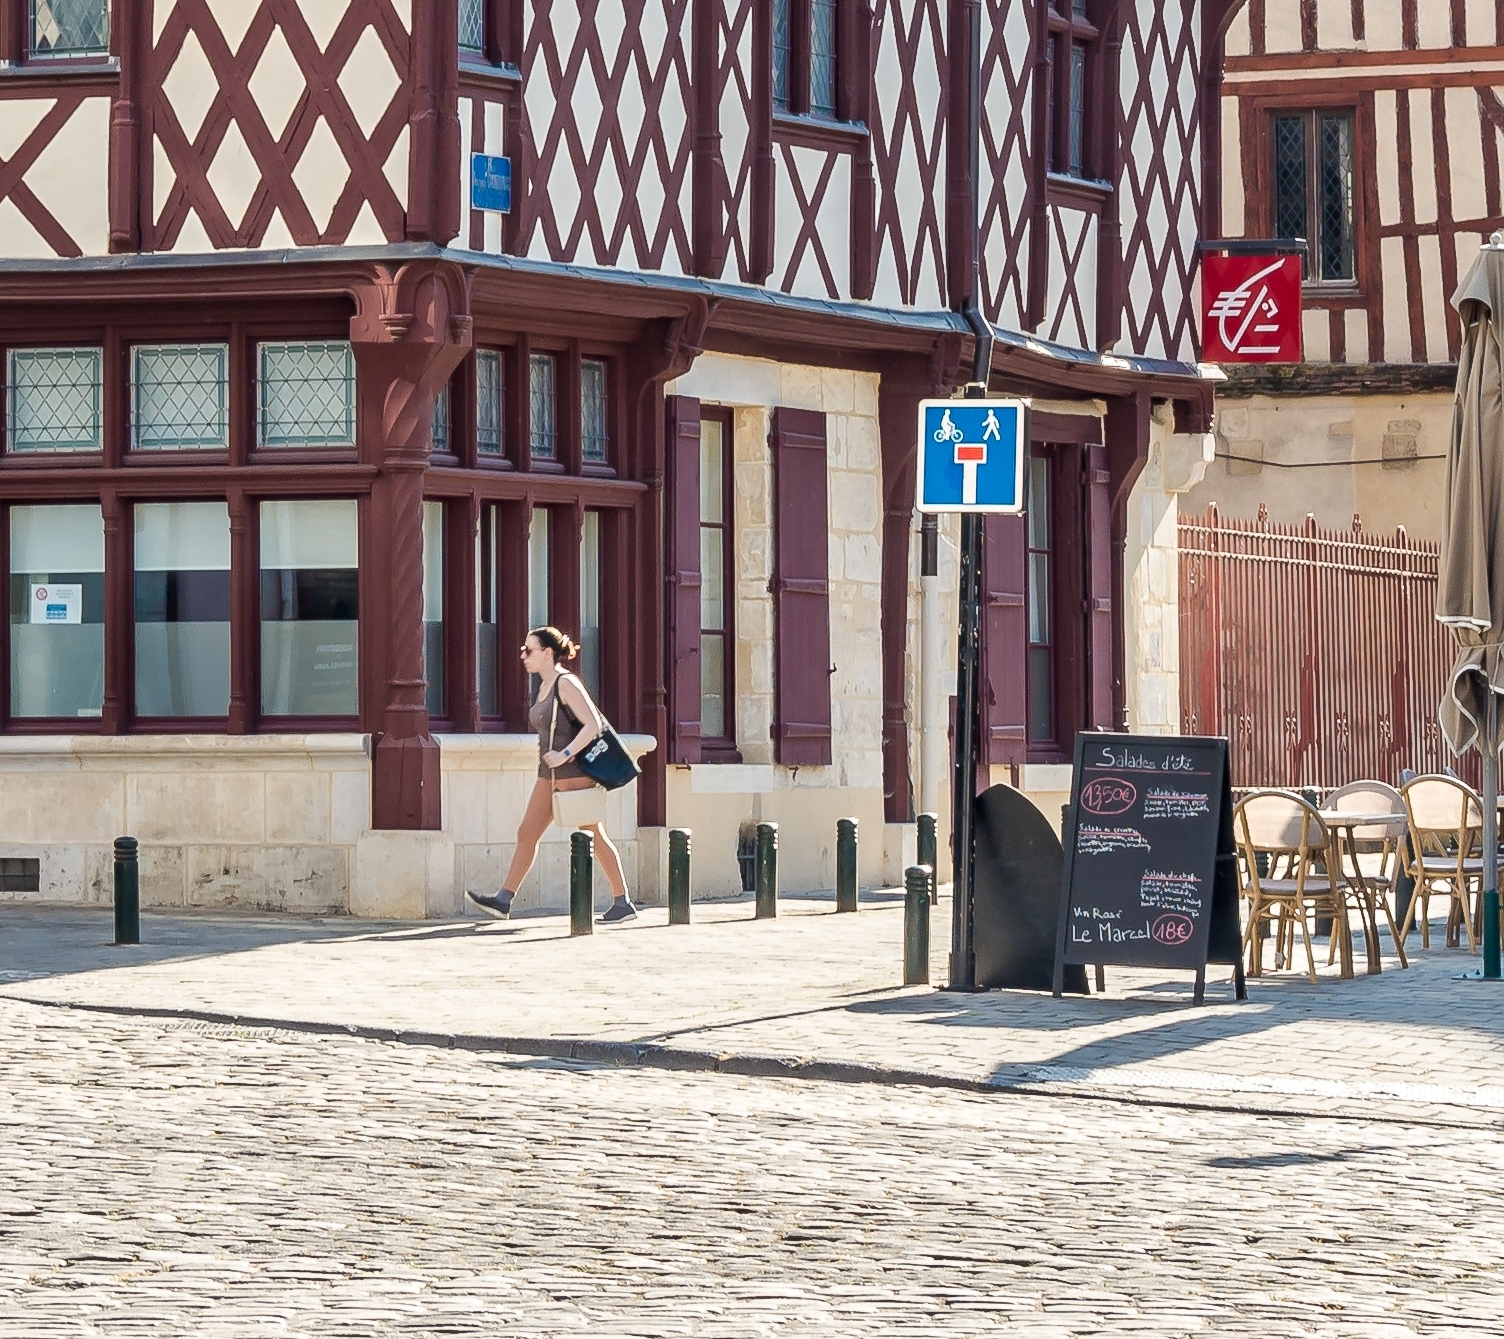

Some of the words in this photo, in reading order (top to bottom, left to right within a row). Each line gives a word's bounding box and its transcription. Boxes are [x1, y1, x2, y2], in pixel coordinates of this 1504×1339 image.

[1095, 747, 1156, 769] Salades
[1085, 784, 1131, 810] 13,50€
[1073, 907, 1090, 918] Vin
[1073, 925, 1092, 942] Le
[1099, 920, 1151, 943] Marcel
[1155, 921, 1187, 940] 18€
